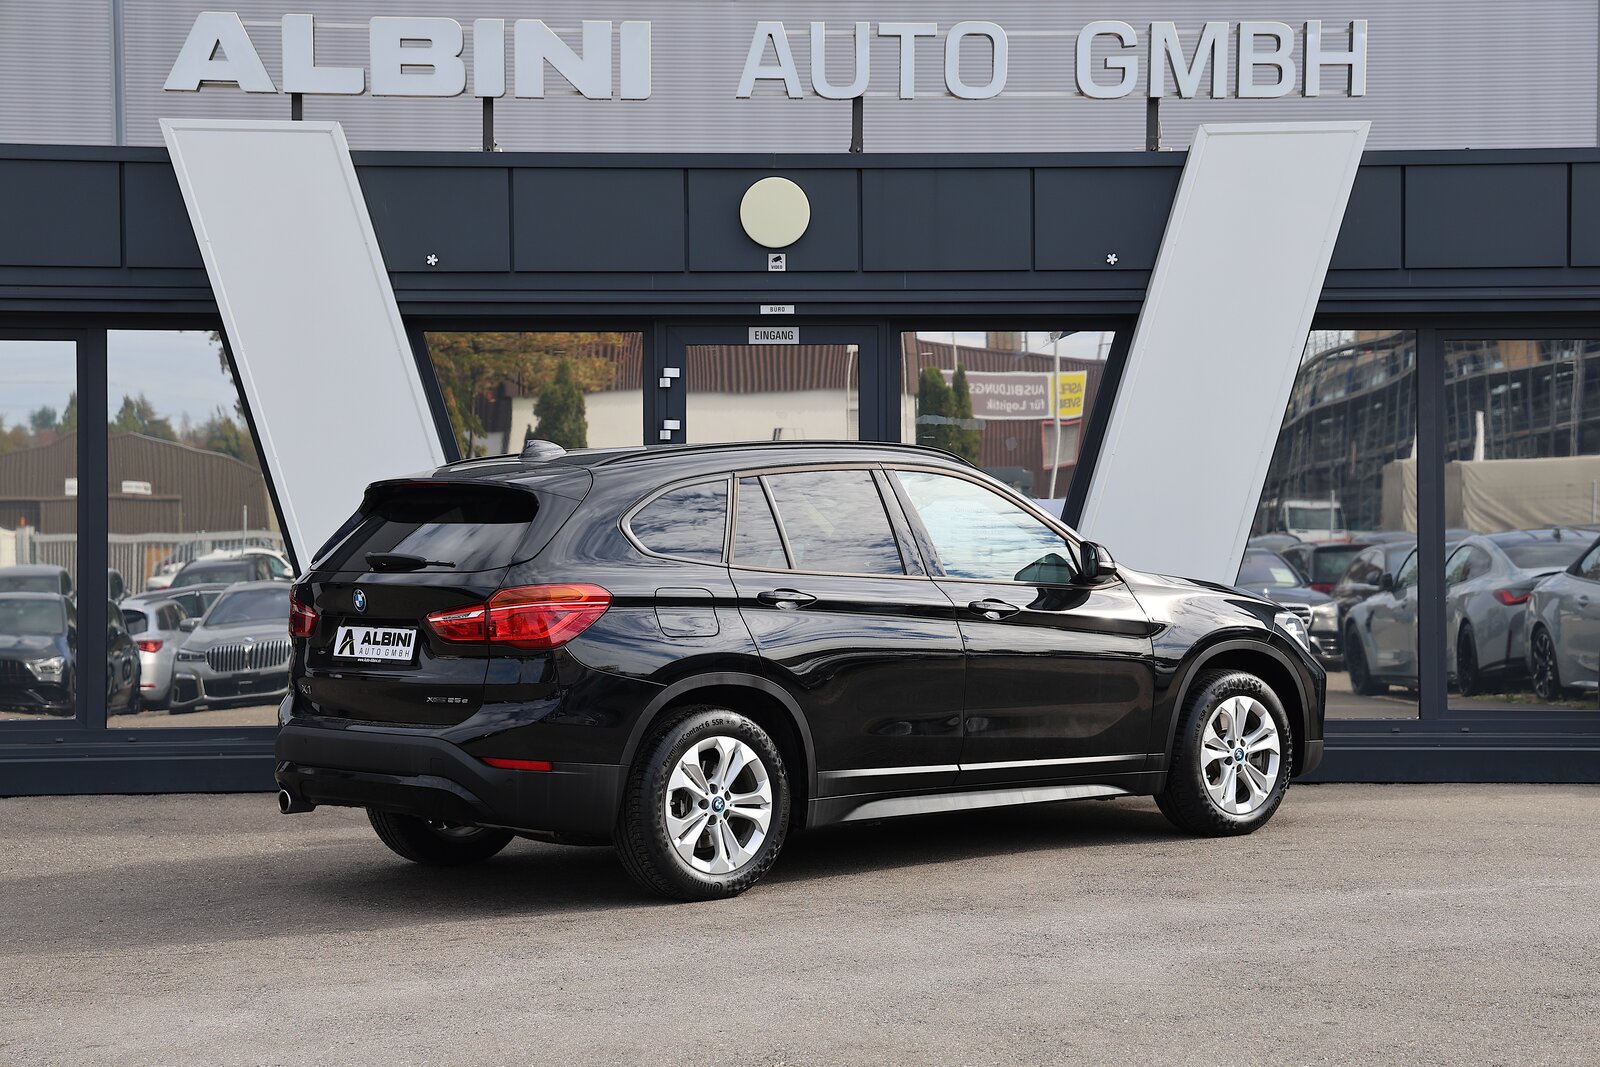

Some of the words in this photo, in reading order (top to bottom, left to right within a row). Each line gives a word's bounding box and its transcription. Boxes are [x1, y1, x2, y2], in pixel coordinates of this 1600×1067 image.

[163, 12, 652, 100] ALBINI
[736, 21, 1009, 100] AUTO
[1075, 19, 1369, 100] GMBH
[754, 330, 794, 341] EINGANG
[360, 631, 412, 648] ALBINI
[358, 647, 381, 656] AUTO
[385, 648, 410, 658] GMBH
[662, 722, 706, 768] PremiumContact
[711, 718, 724, 727] SSR
